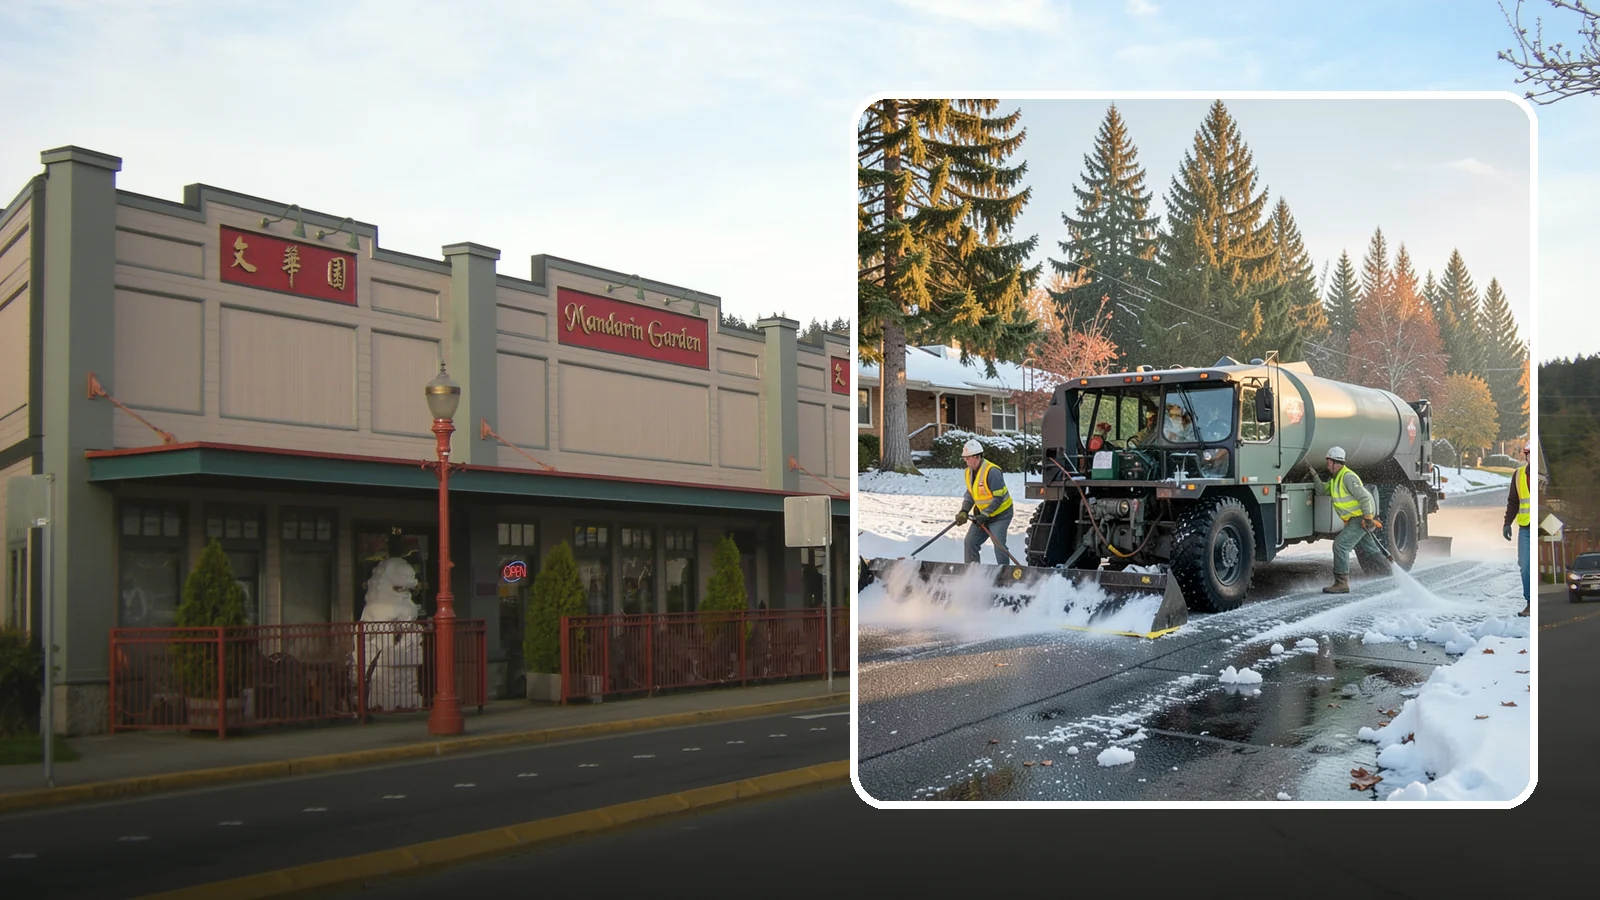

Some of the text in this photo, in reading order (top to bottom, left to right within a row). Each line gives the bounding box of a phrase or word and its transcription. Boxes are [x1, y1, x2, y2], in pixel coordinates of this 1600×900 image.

[231, 236, 346, 290] 文華園
[564, 302, 702, 352] Mandarin Garden
[503, 565, 527, 578] OPEN
